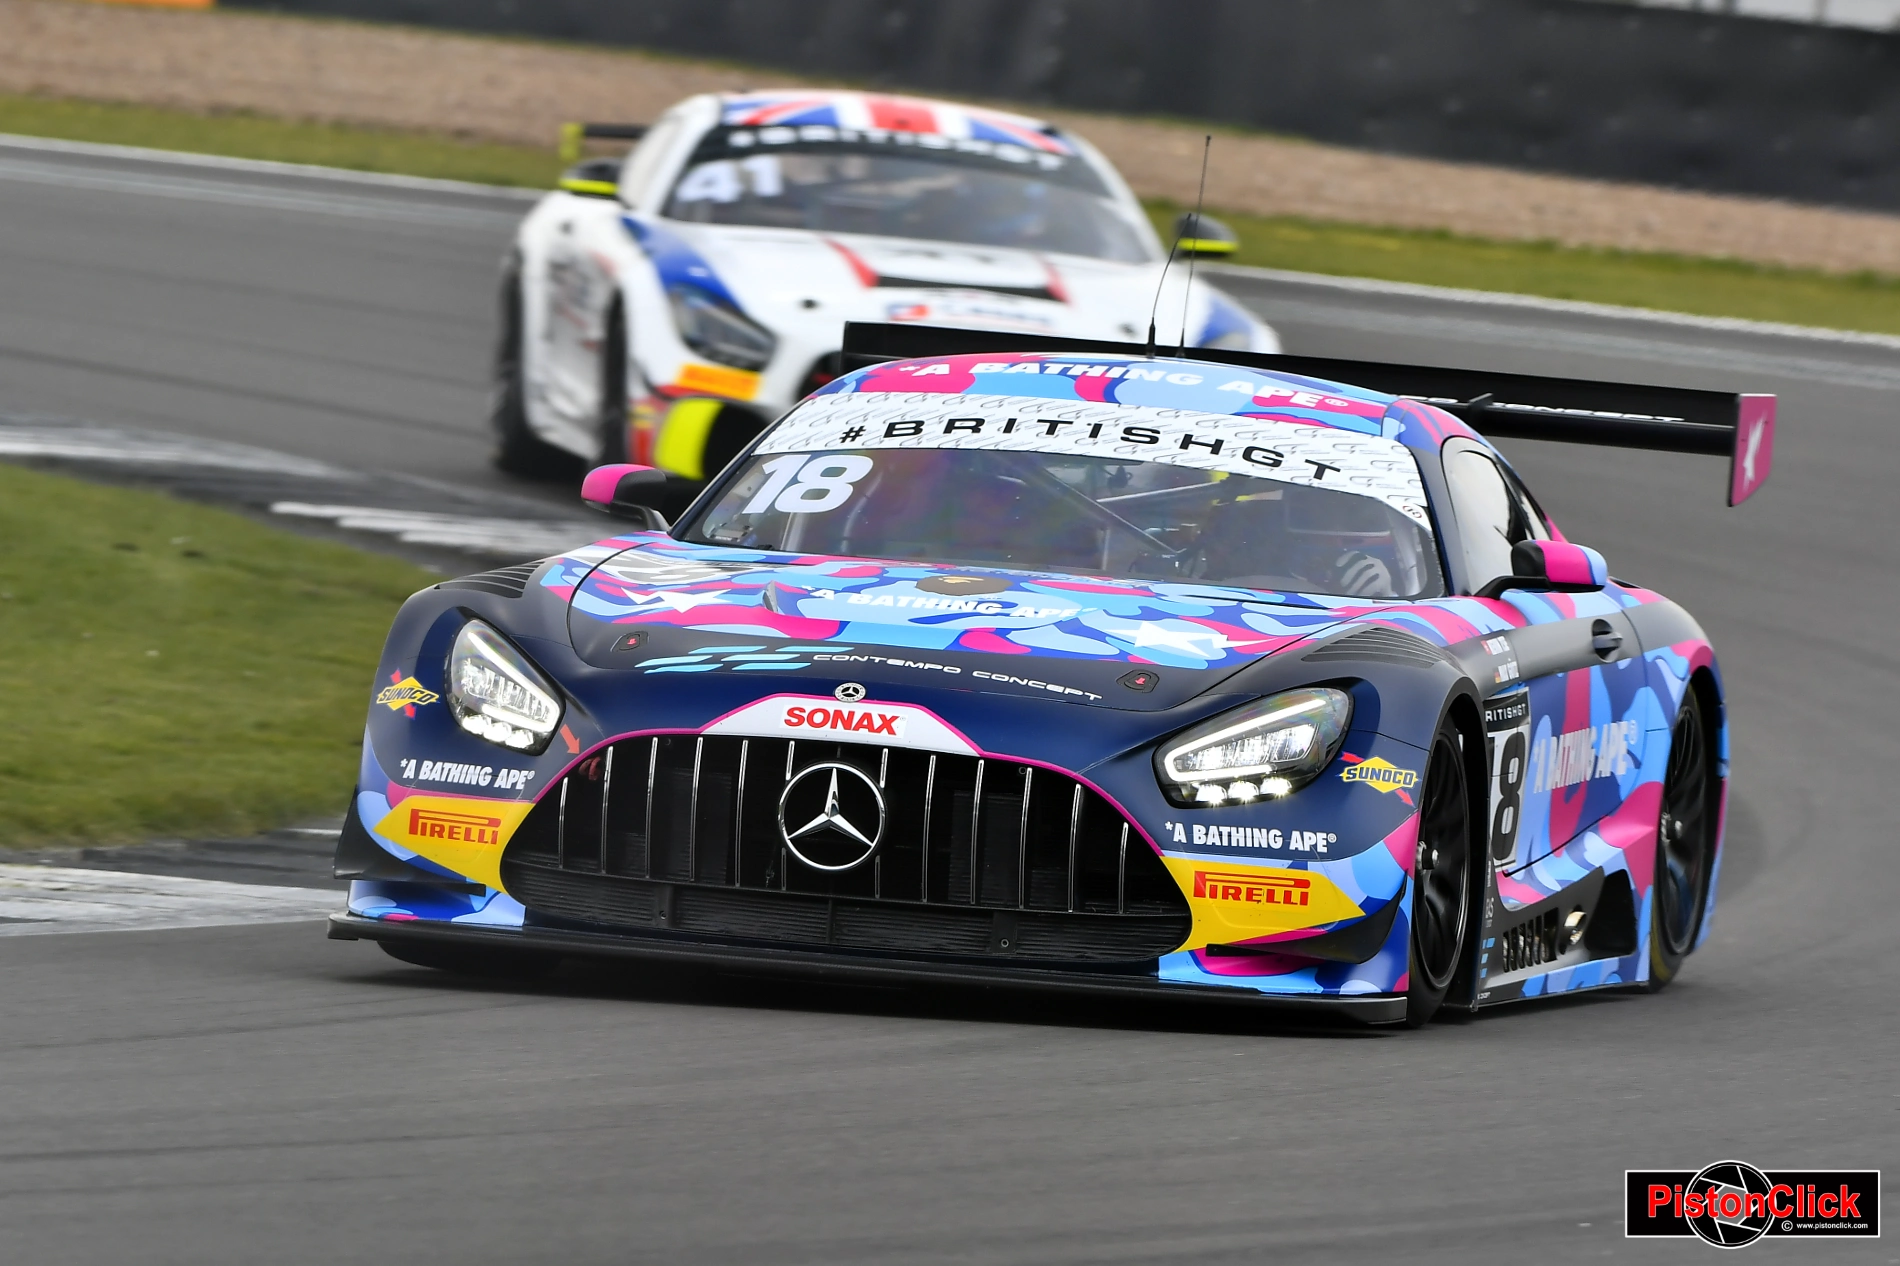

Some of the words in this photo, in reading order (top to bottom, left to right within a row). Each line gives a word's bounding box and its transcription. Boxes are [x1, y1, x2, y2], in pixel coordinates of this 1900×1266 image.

[969, 362, 1204, 386] BATHING
[839, 418, 1341, 480] #BRITISHGT
[742, 454, 873, 514] 18
[847, 593, 1003, 615] BATHING
[812, 654, 962, 674] CONTEMPO
[972, 670, 1103, 702] CONCEPT
[380, 687, 437, 703] SUNOCO
[1485, 703, 1526, 722] RITISHGT
[418, 760, 493, 787] BATHING
[1345, 766, 1415, 786] SUNOCO
[1491, 731, 1526, 861] 8
[408, 808, 502, 845] PIRELLI
[1192, 824, 1283, 849] BATHING
[1193, 870, 1311, 906] PIRELLI
